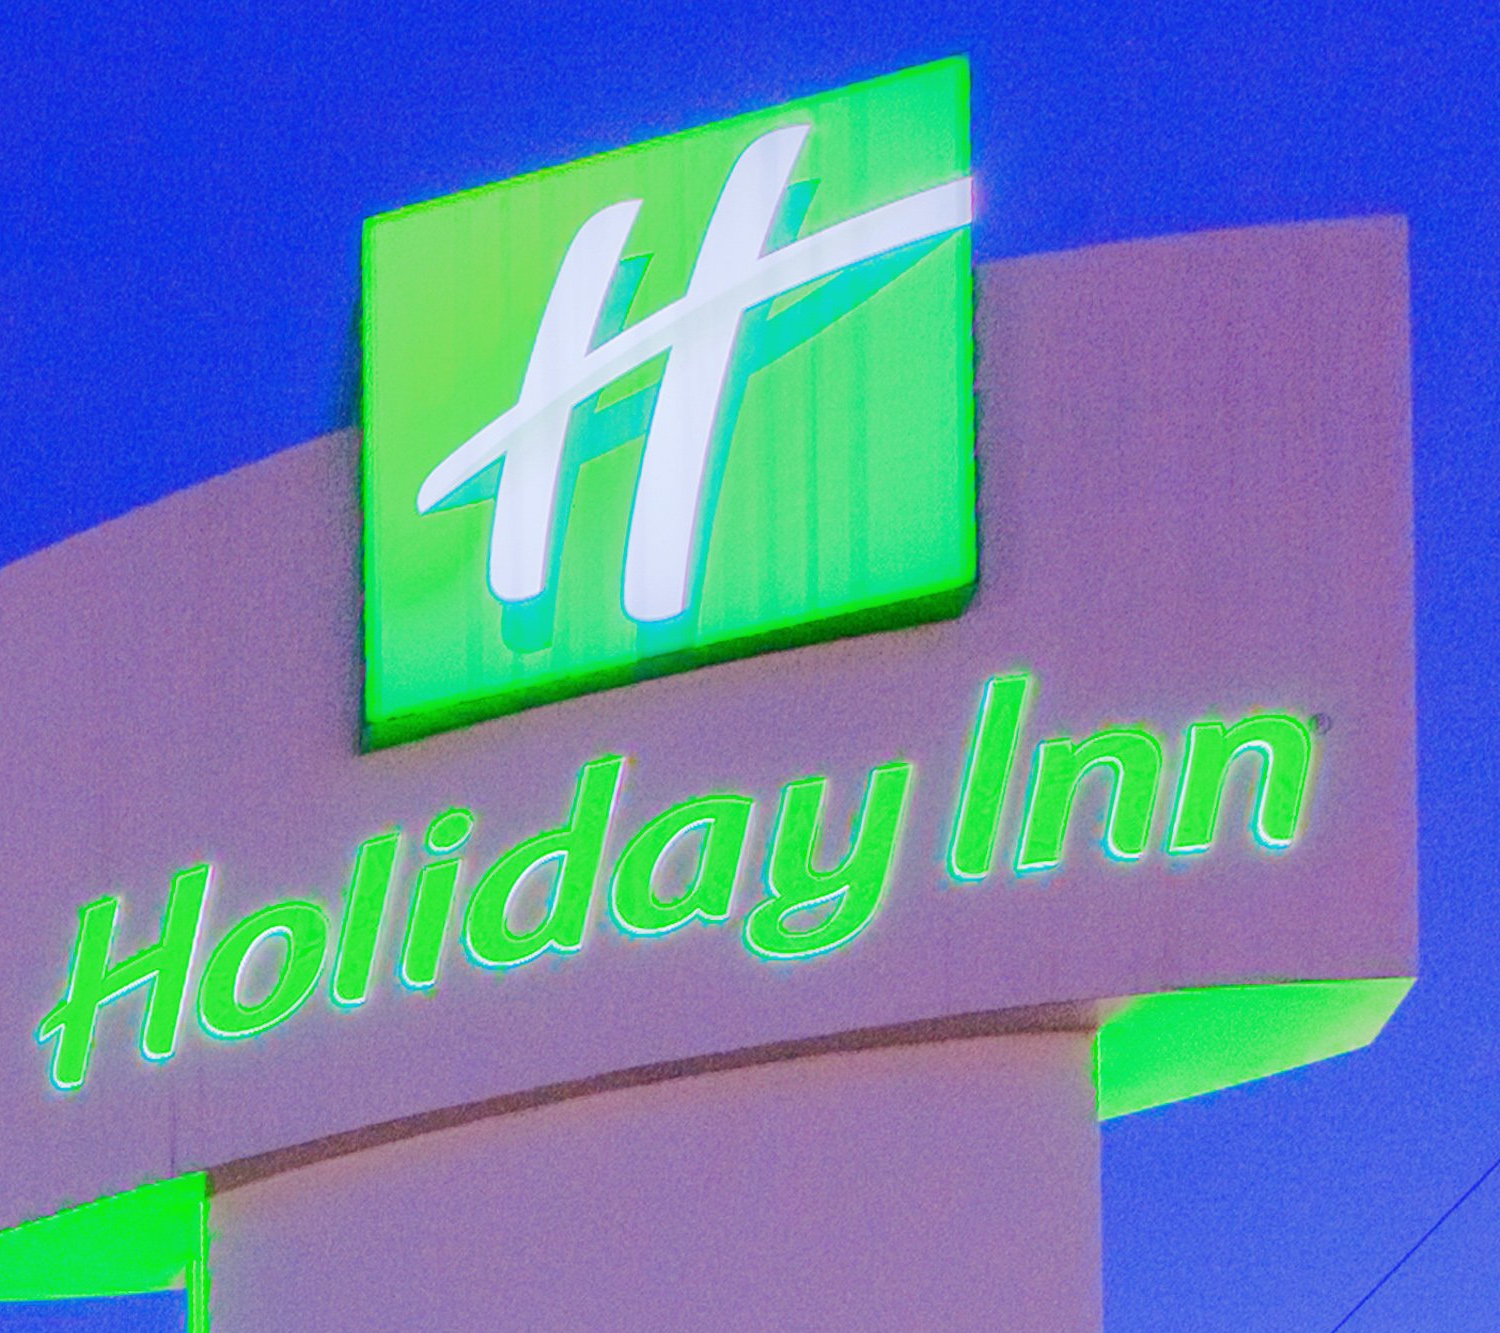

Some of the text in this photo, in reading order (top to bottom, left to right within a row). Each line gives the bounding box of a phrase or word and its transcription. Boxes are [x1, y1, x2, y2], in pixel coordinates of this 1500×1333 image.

[416, 124, 973, 622] H
[36, 674, 1312, 1091] Holiday Inn
